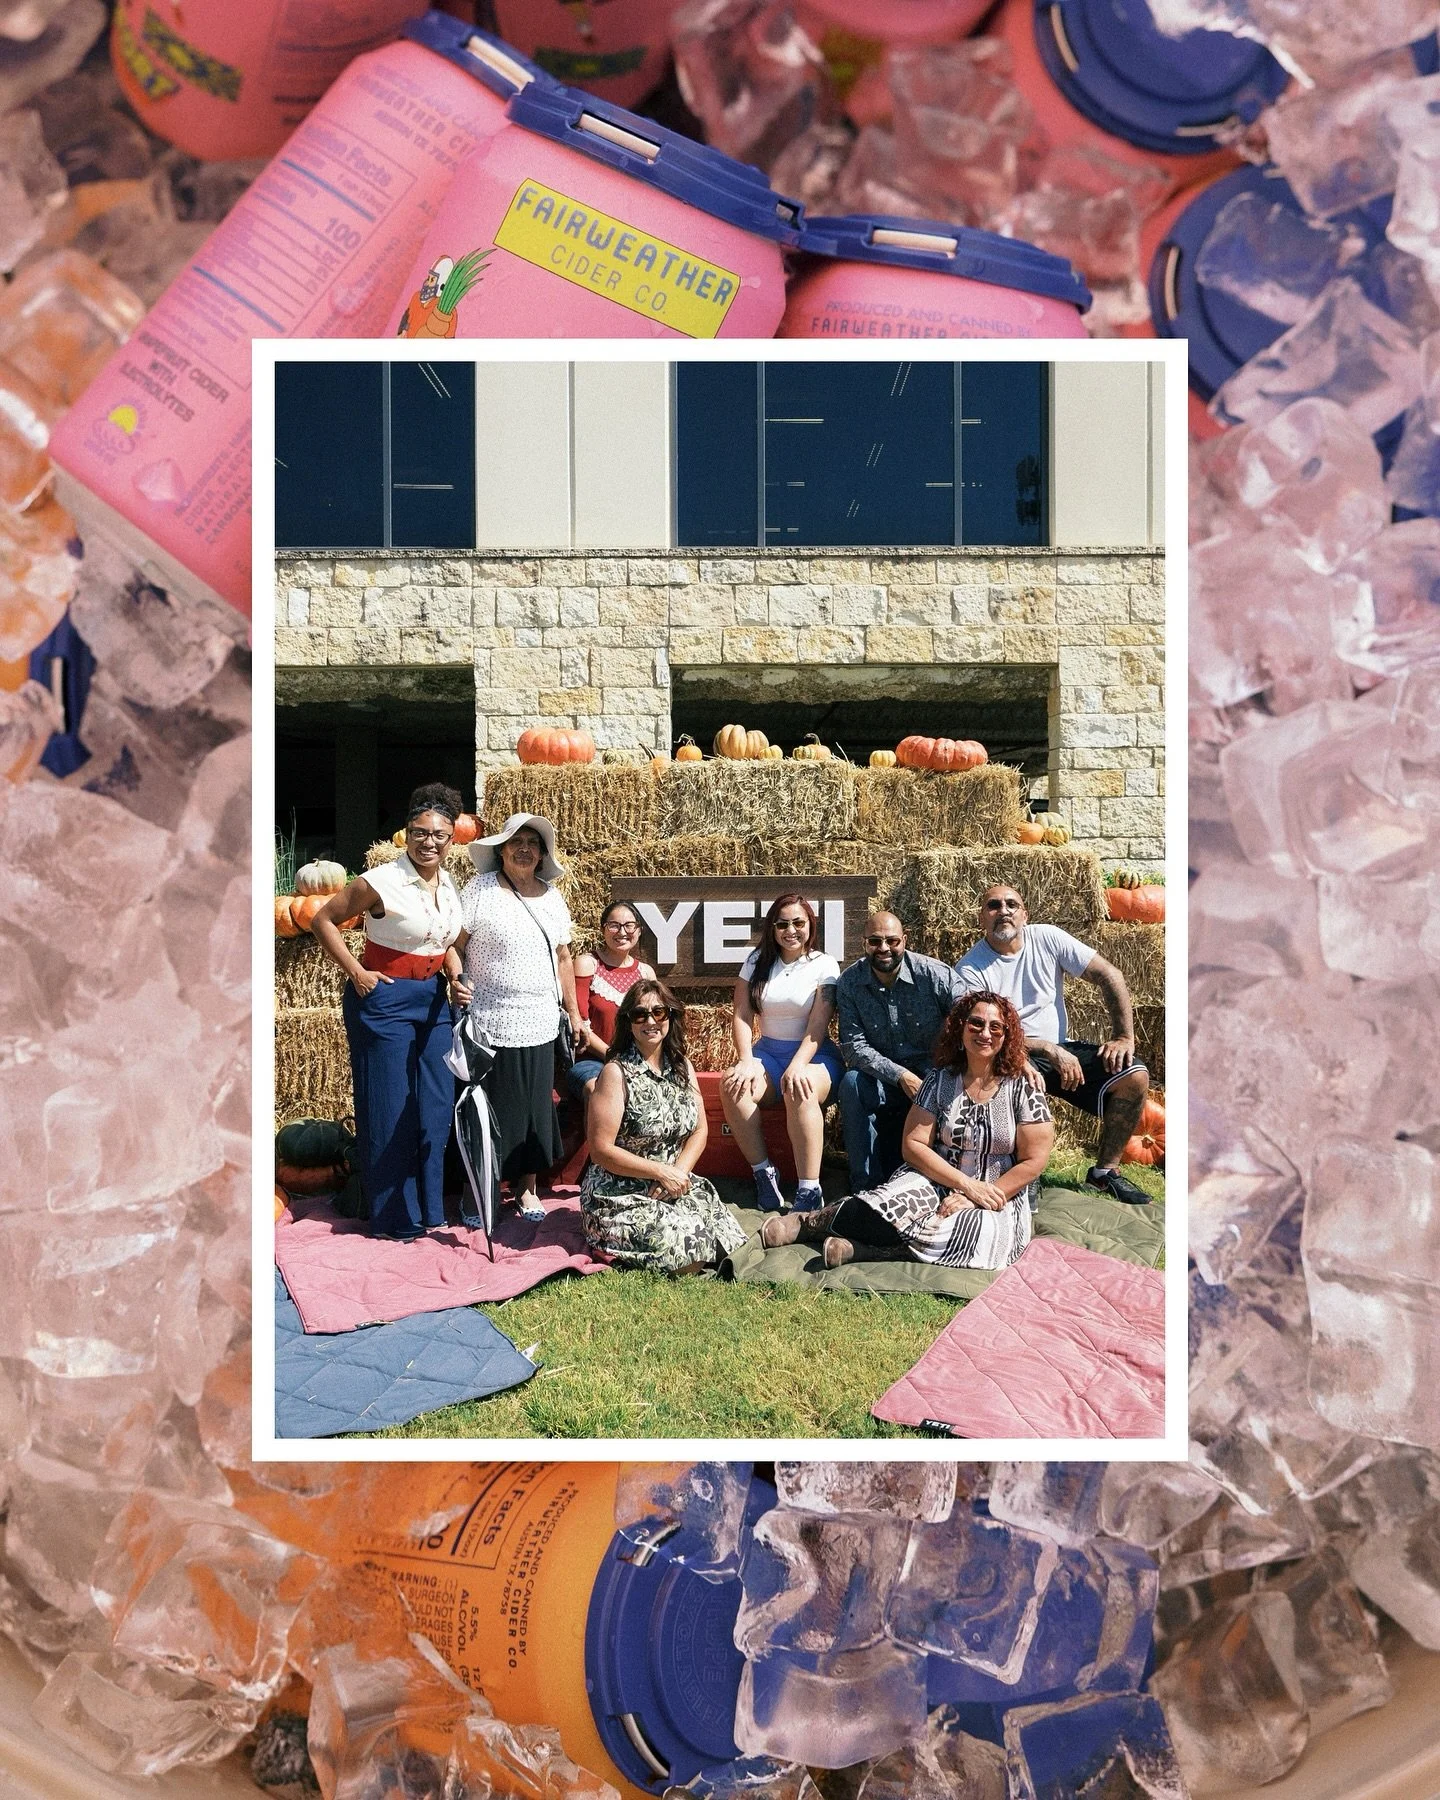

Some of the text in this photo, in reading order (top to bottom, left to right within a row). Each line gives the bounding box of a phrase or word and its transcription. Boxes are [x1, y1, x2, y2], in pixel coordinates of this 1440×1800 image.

[324, 217, 362, 251] 100
[515, 186, 734, 307] FAIRWEATHER
[550, 245, 668, 315] CIDER CO.
[811, 316, 948, 339] FAIRWEATHER
[824, 301, 902, 318] PRODUCED
[906, 309, 944, 323] AND
[950, 313, 1014, 335] CANNED
[188, 366, 230, 404] CIDER
[483, 1489, 526, 1545] Facts
[517, 1481, 576, 1580] FAIRWEATHER
[500, 1521, 534, 1616] AUSTIN TX 78758
[518, 1489, 580, 1656] PRODUCED AND CANNED BY
[408, 1586, 456, 1605] SURGEON
[434, 1604, 454, 1619] NOT
[508, 1588, 522, 1638] CIDER
[416, 1616, 454, 1633] ERAGES
[470, 1606, 480, 1641] 5.5%
[472, 1667, 481, 1682] 12
